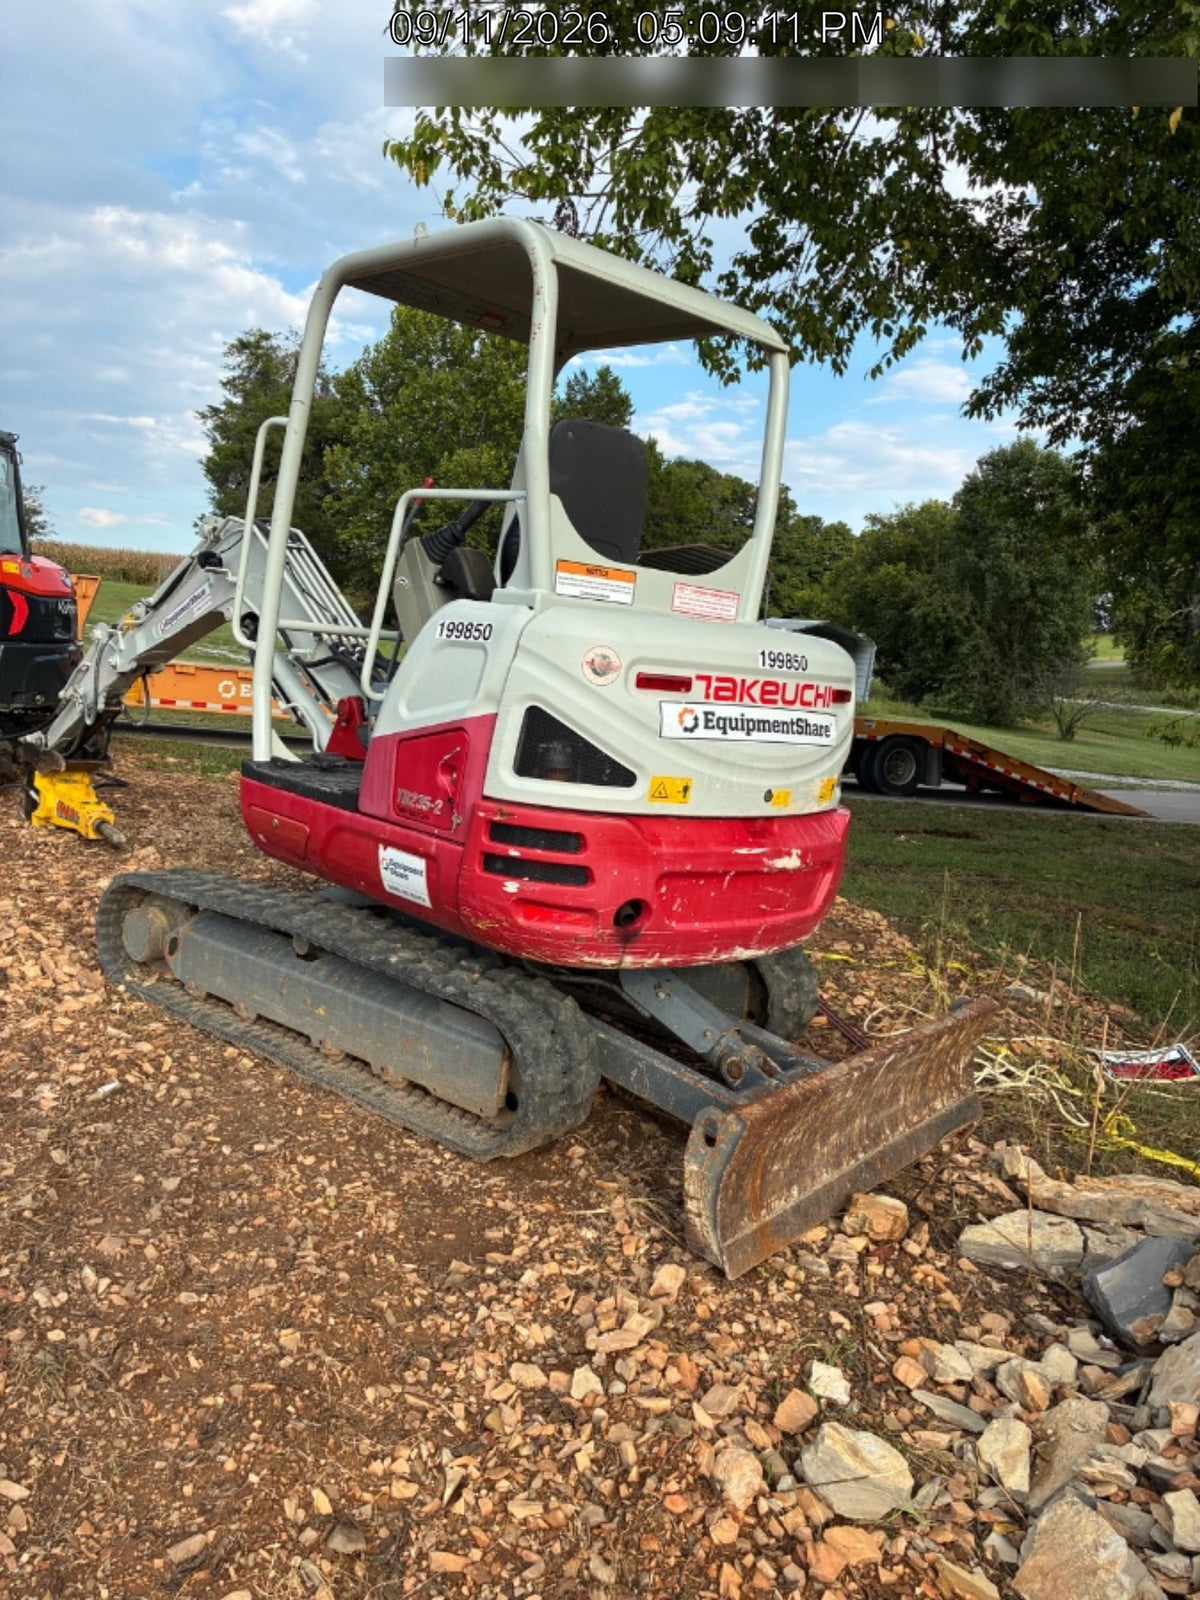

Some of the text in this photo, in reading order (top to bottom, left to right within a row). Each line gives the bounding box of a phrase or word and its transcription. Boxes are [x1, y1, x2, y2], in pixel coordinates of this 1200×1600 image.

[438, 621, 493, 641] 199850
[759, 650, 809, 672] 199850
[703, 710, 831, 738] EquipmentShare
